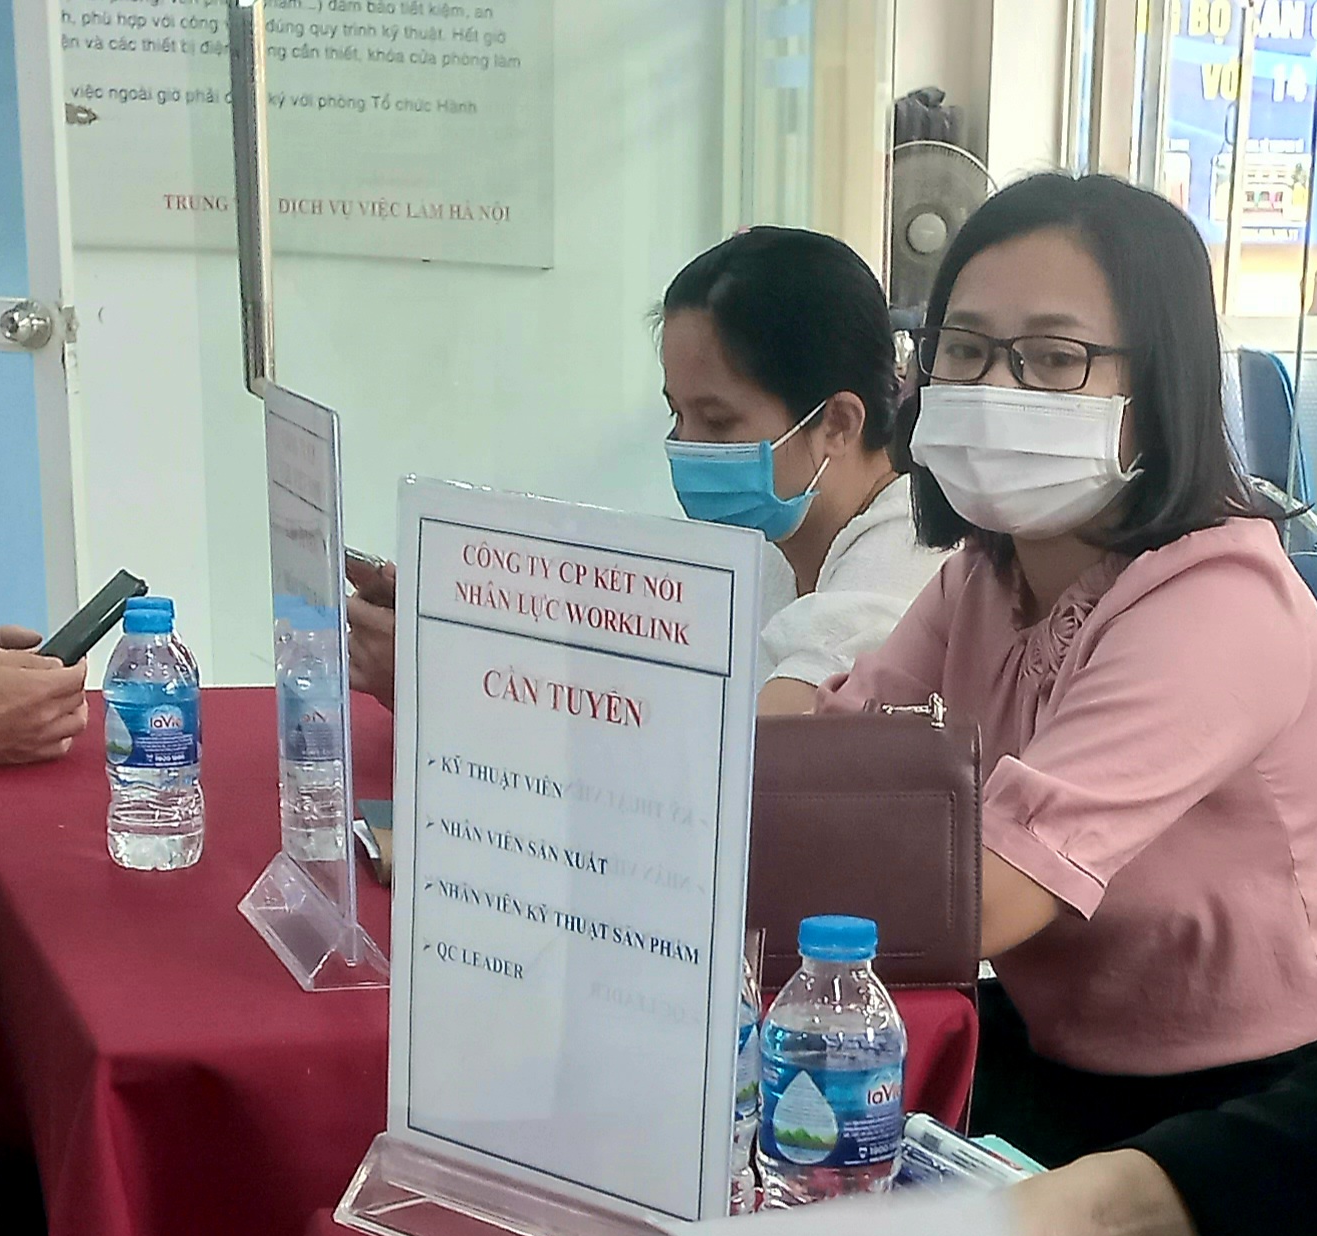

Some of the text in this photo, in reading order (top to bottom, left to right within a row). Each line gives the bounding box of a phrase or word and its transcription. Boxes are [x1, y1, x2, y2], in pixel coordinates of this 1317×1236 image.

[309, 22, 337, 39] quy
[164, 194, 228, 211] TRUNG
[278, 197, 323, 215] DỊCH
[329, 198, 351, 219] VỤ
[358, 197, 399, 220] VIỆC
[481, 202, 511, 223] NỘI
[463, 540, 684, 604] CÔNG TY CP KẾT NỐI
[455, 579, 691, 647] NHÂN LỰC WORKLINK
[482, 662, 644, 729] CẦN TUYỂN
[440, 755, 564, 800] KỸ THUẬT VIÊN
[440, 817, 609, 876] NHÂN VIÊN SẢN XUẤT
[440, 878, 483, 905] NHÂN
[486, 888, 523, 917] VIÊN
[527, 897, 551, 924] KỸ
[554, 910, 610, 942] THUẬT
[650, 936, 700, 966] PHẨM
[437, 942, 524, 980] QC LEADER
